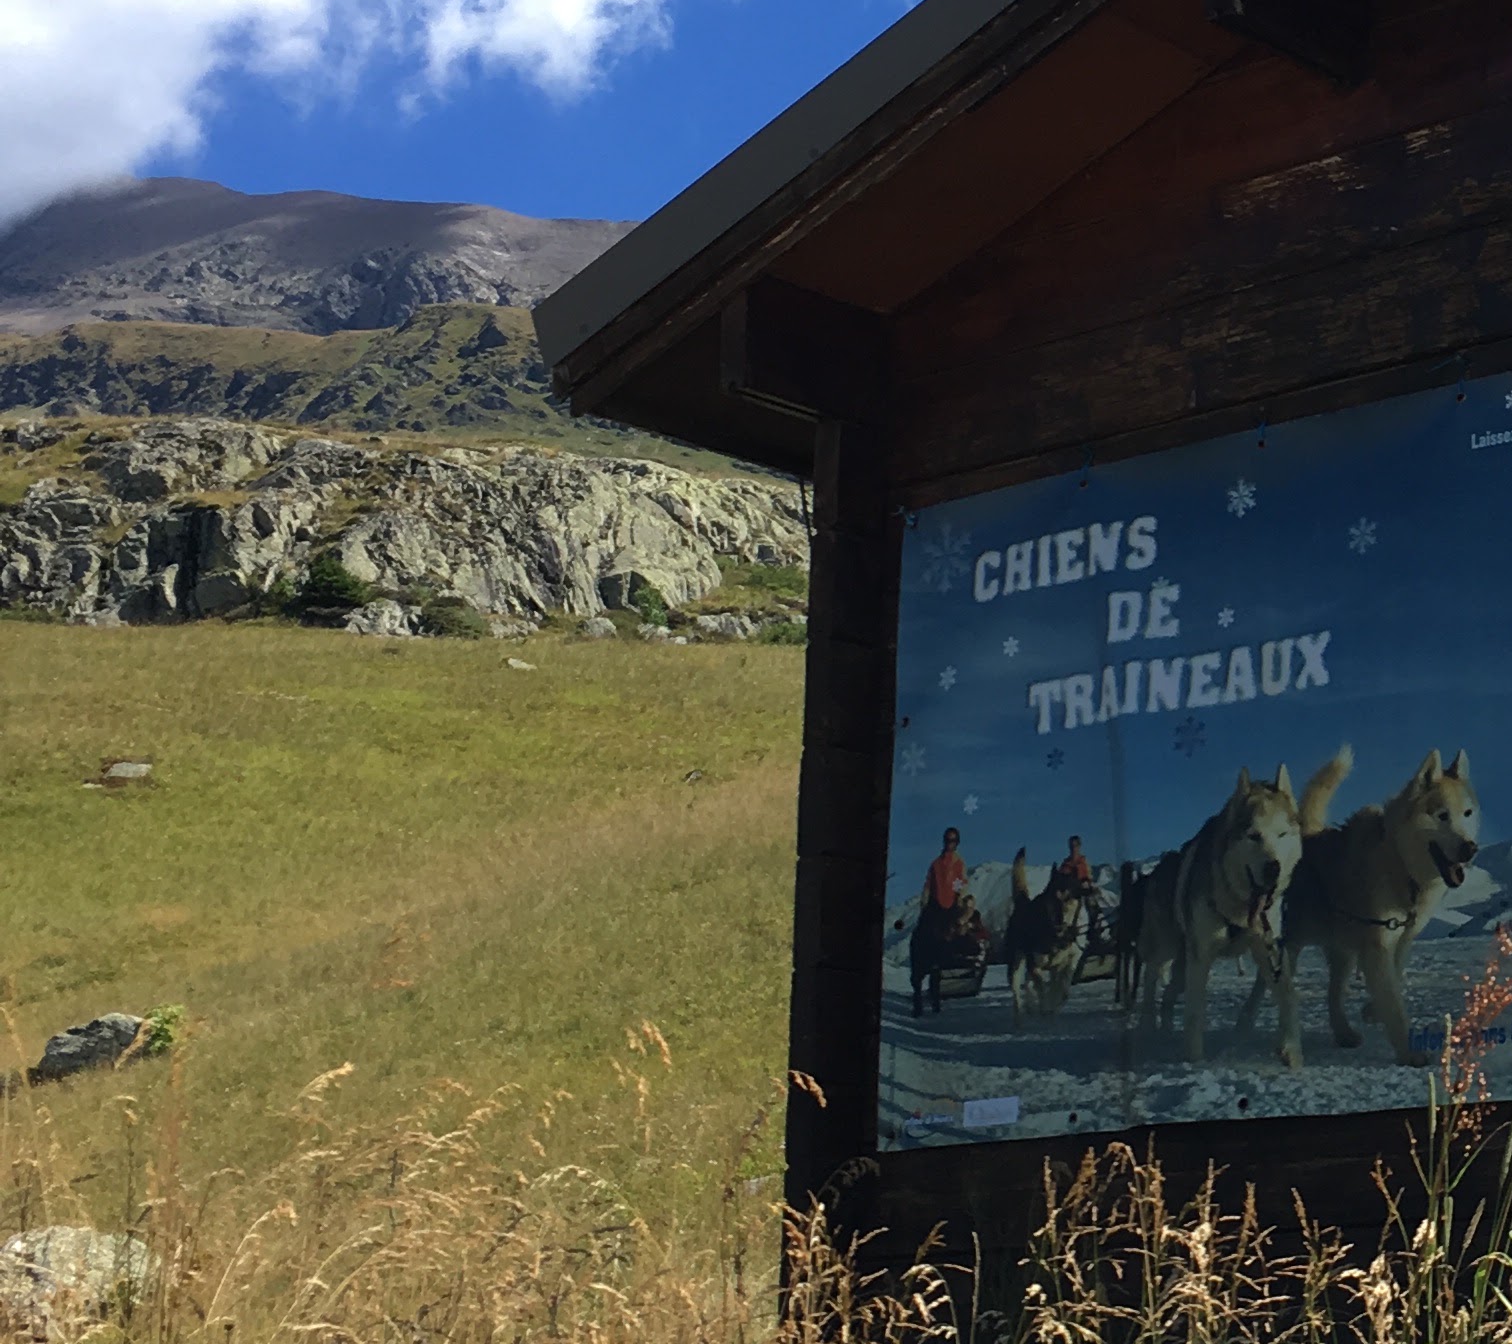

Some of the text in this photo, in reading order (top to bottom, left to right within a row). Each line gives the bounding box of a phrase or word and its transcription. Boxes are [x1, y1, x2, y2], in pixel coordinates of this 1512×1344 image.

[973, 515, 1158, 603] CHIENS
[1107, 583, 1180, 644] DE
[1027, 630, 1333, 735] TRAINEAUX
